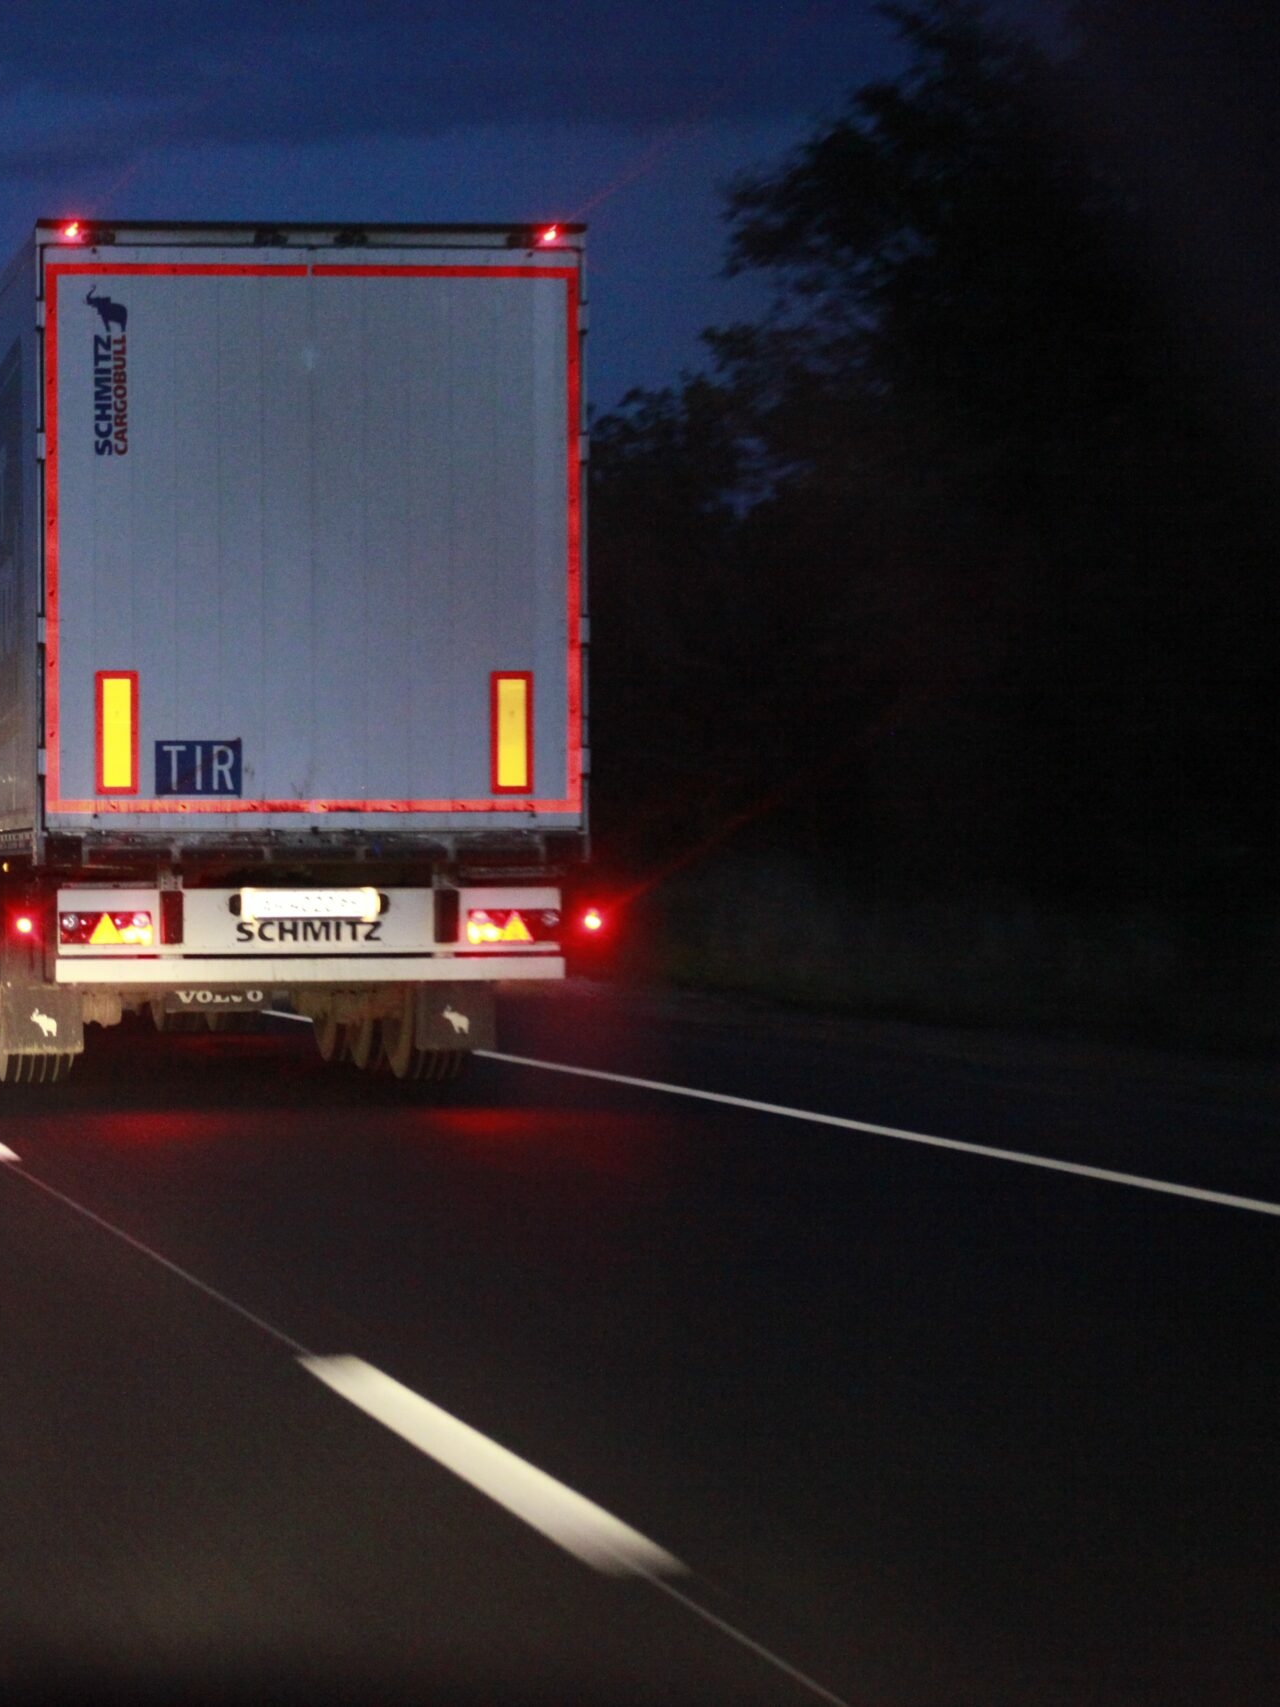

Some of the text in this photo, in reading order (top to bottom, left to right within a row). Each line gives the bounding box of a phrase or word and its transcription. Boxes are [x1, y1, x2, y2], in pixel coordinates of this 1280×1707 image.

[93, 333, 113, 457] SCHMITZ
[113, 333, 128, 456] CARGOBULL
[162, 745, 235, 791] TIR
[236, 920, 382, 942] SCHMITZ
